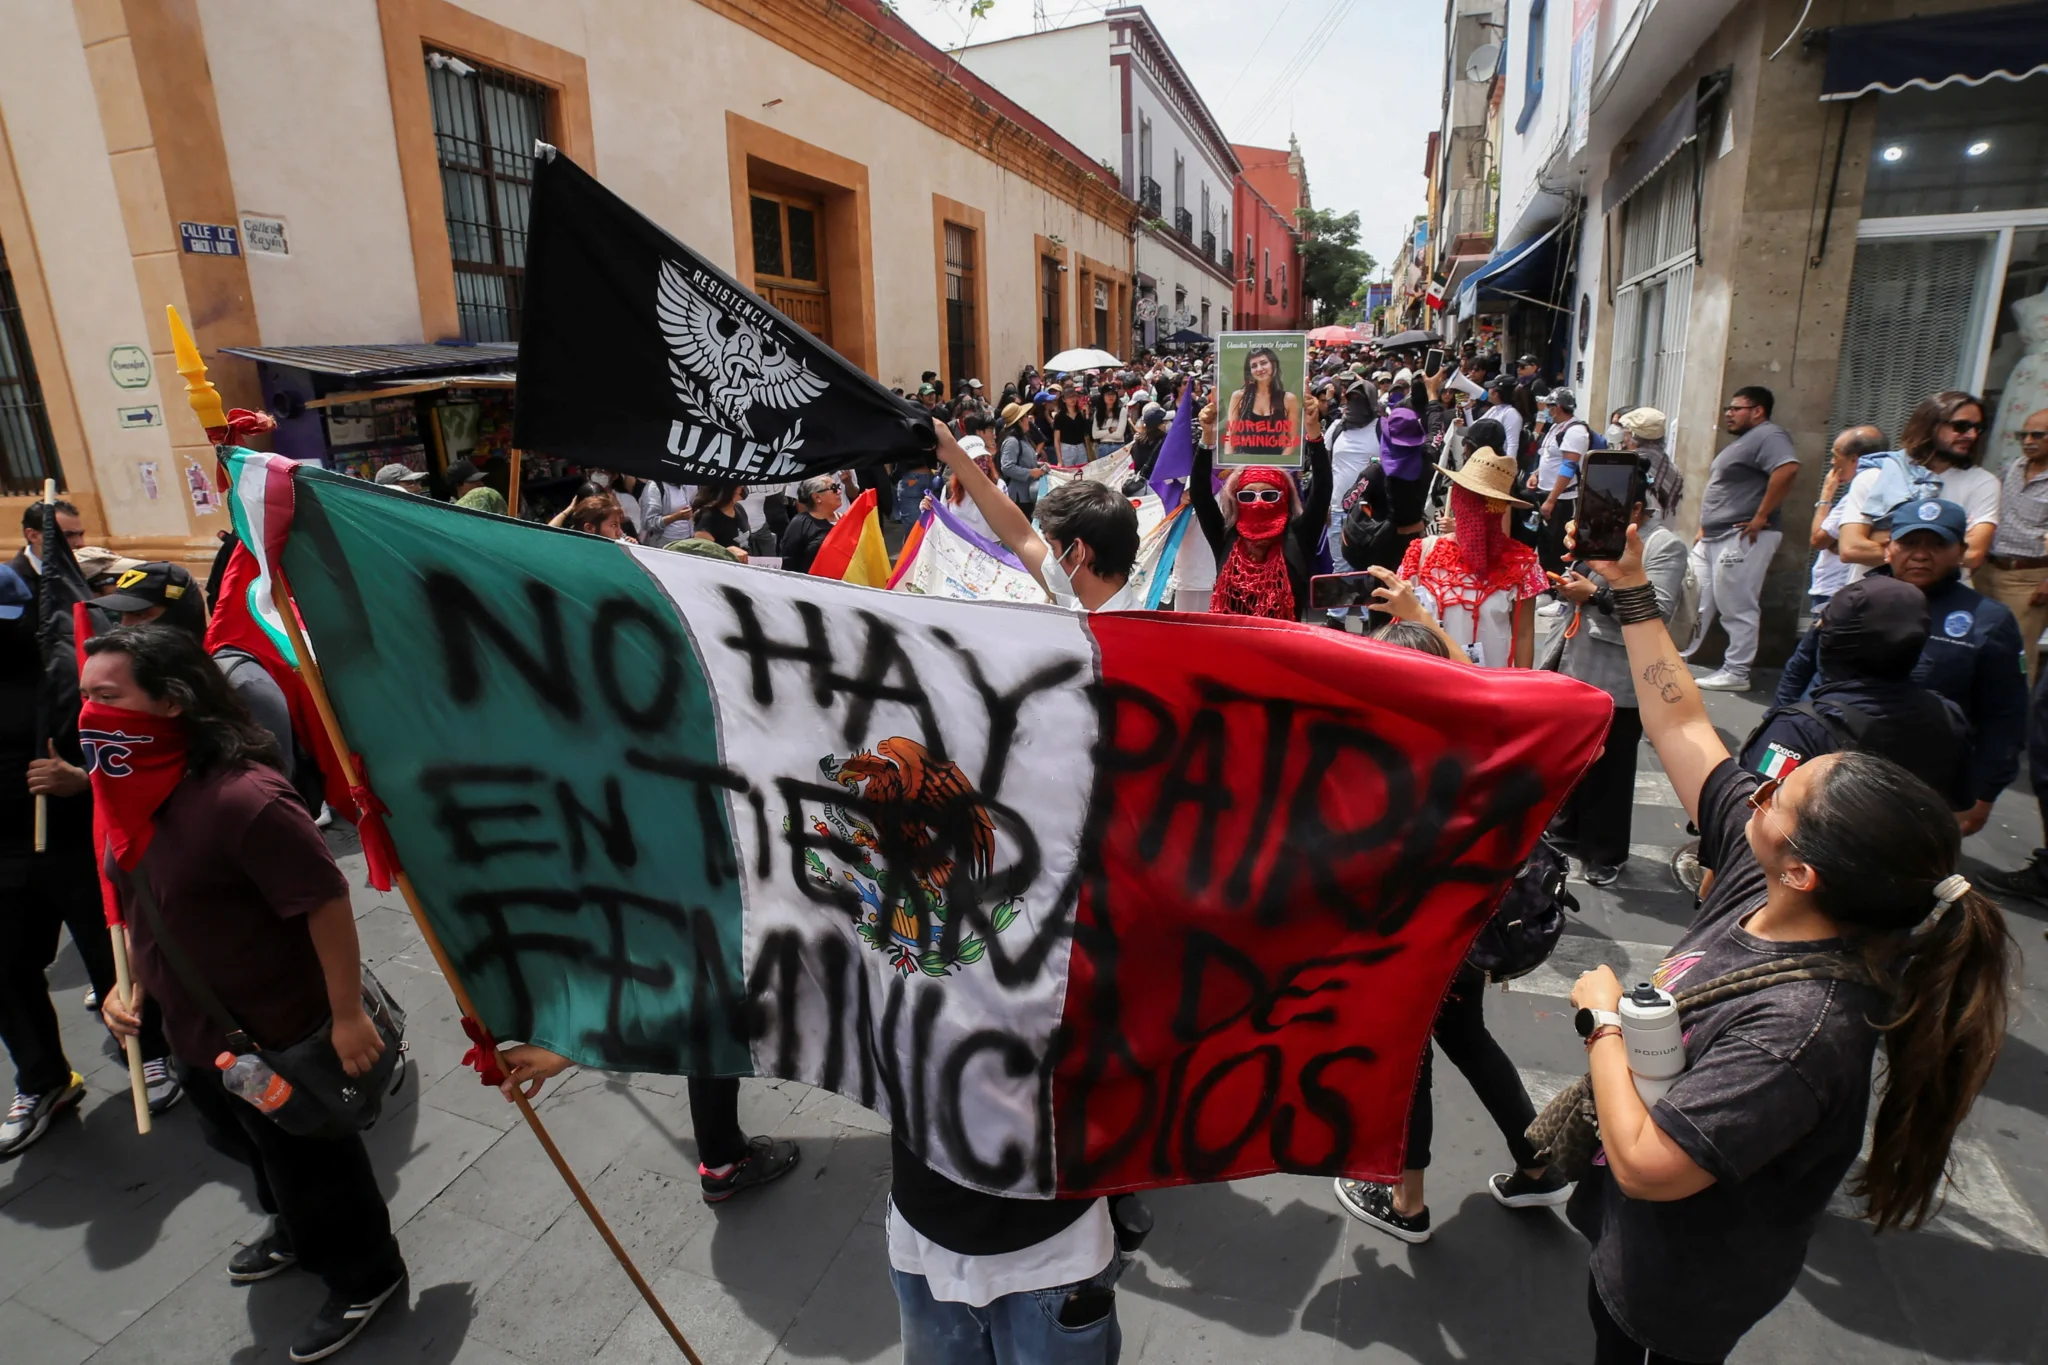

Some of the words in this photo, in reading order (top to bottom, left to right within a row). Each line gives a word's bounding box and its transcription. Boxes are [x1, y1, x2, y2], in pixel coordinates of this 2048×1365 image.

[180, 223, 212, 240] CALLE
[243, 219, 270, 235] Calle
[692, 269, 774, 332] RESISTENCIA
[1226, 419, 1293, 433] MORELOS
[666, 419, 807, 477] UAEM
[684, 462, 769, 482] MEDICINA
[422, 566, 686, 735] NO
[715, 580, 1084, 800] HAY
[1084, 670, 1548, 938] PATRIA
[1768, 742, 1801, 760] MÉXICO
[420, 762, 640, 875] EN
[1170, 922, 1406, 1046] DE
[1634, 1045, 1679, 1057] PODIUM
